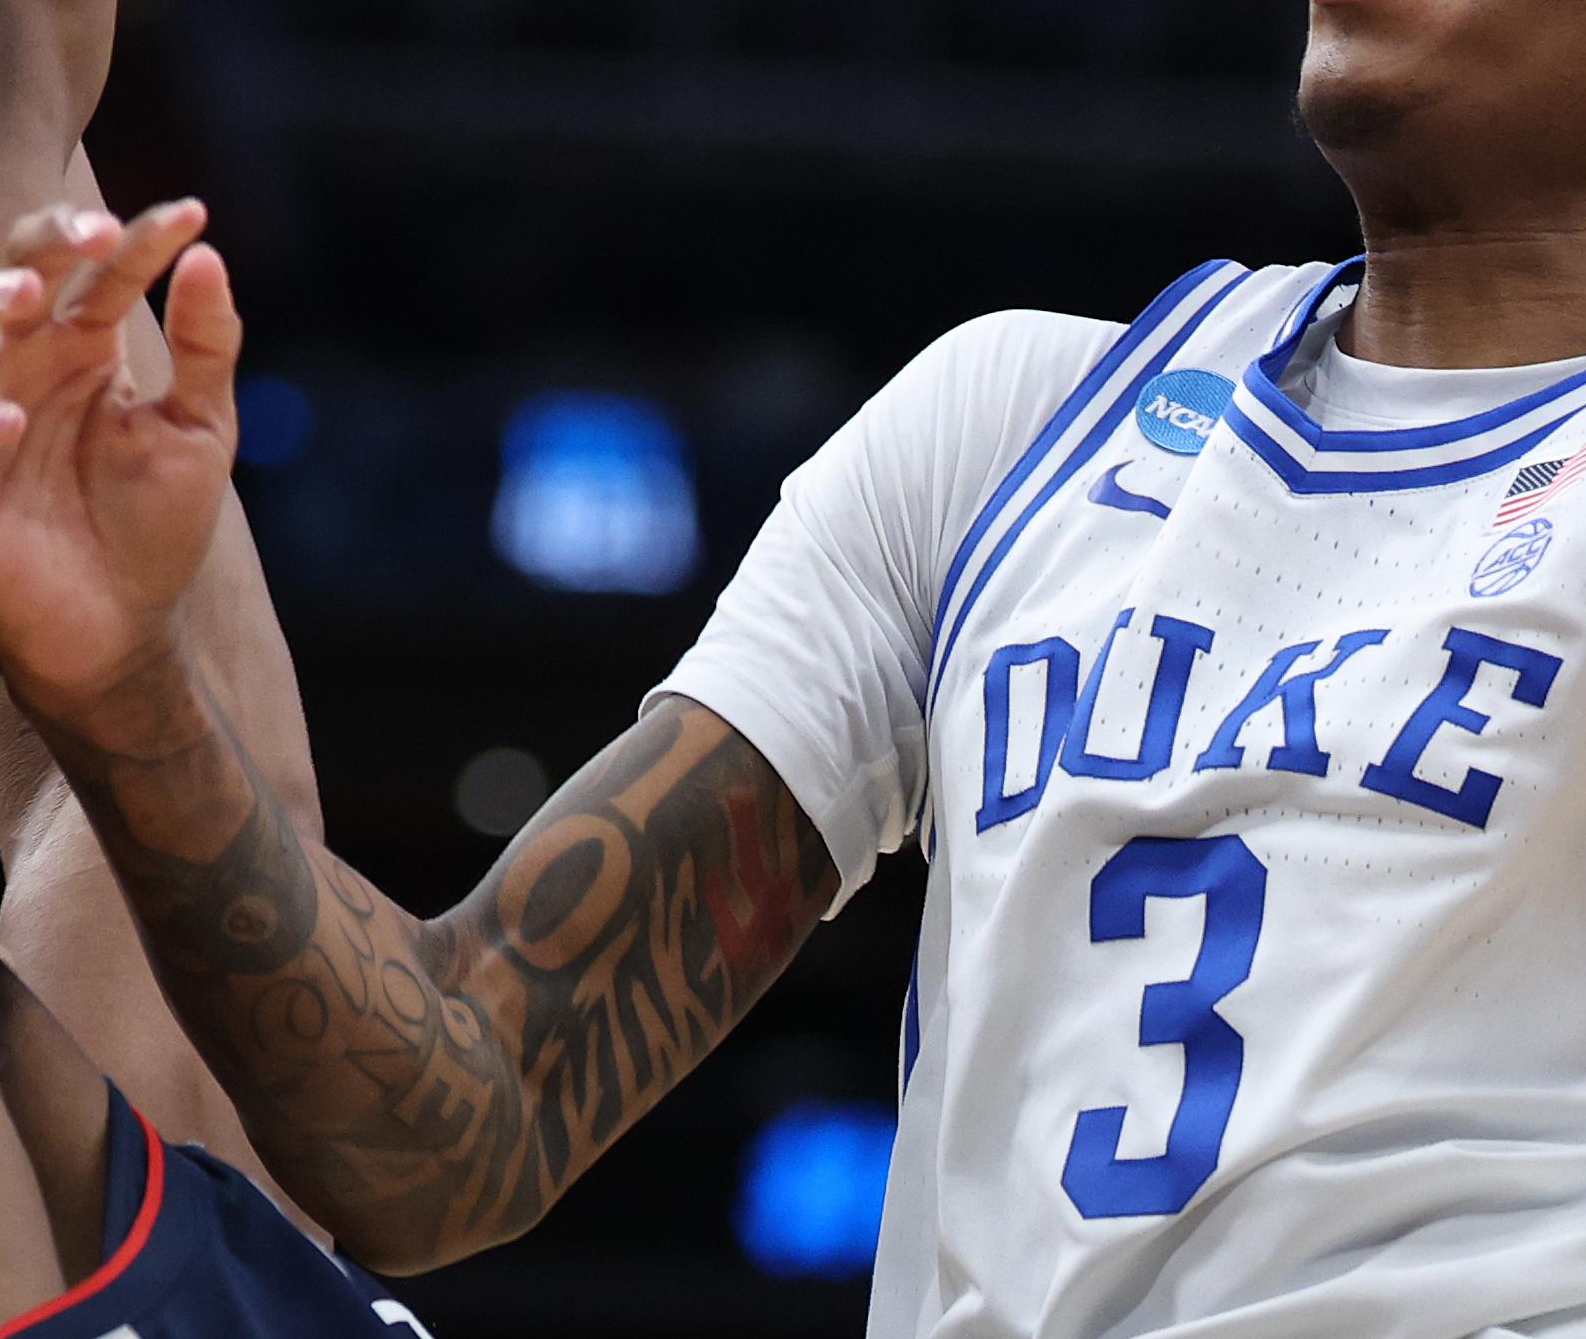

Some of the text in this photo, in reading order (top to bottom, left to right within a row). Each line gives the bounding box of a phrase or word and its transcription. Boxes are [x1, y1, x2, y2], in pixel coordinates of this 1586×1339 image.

[1144, 394, 1218, 438] NCA
[975, 606, 1564, 836] DUKE
[1060, 834, 1268, 1220] 3
